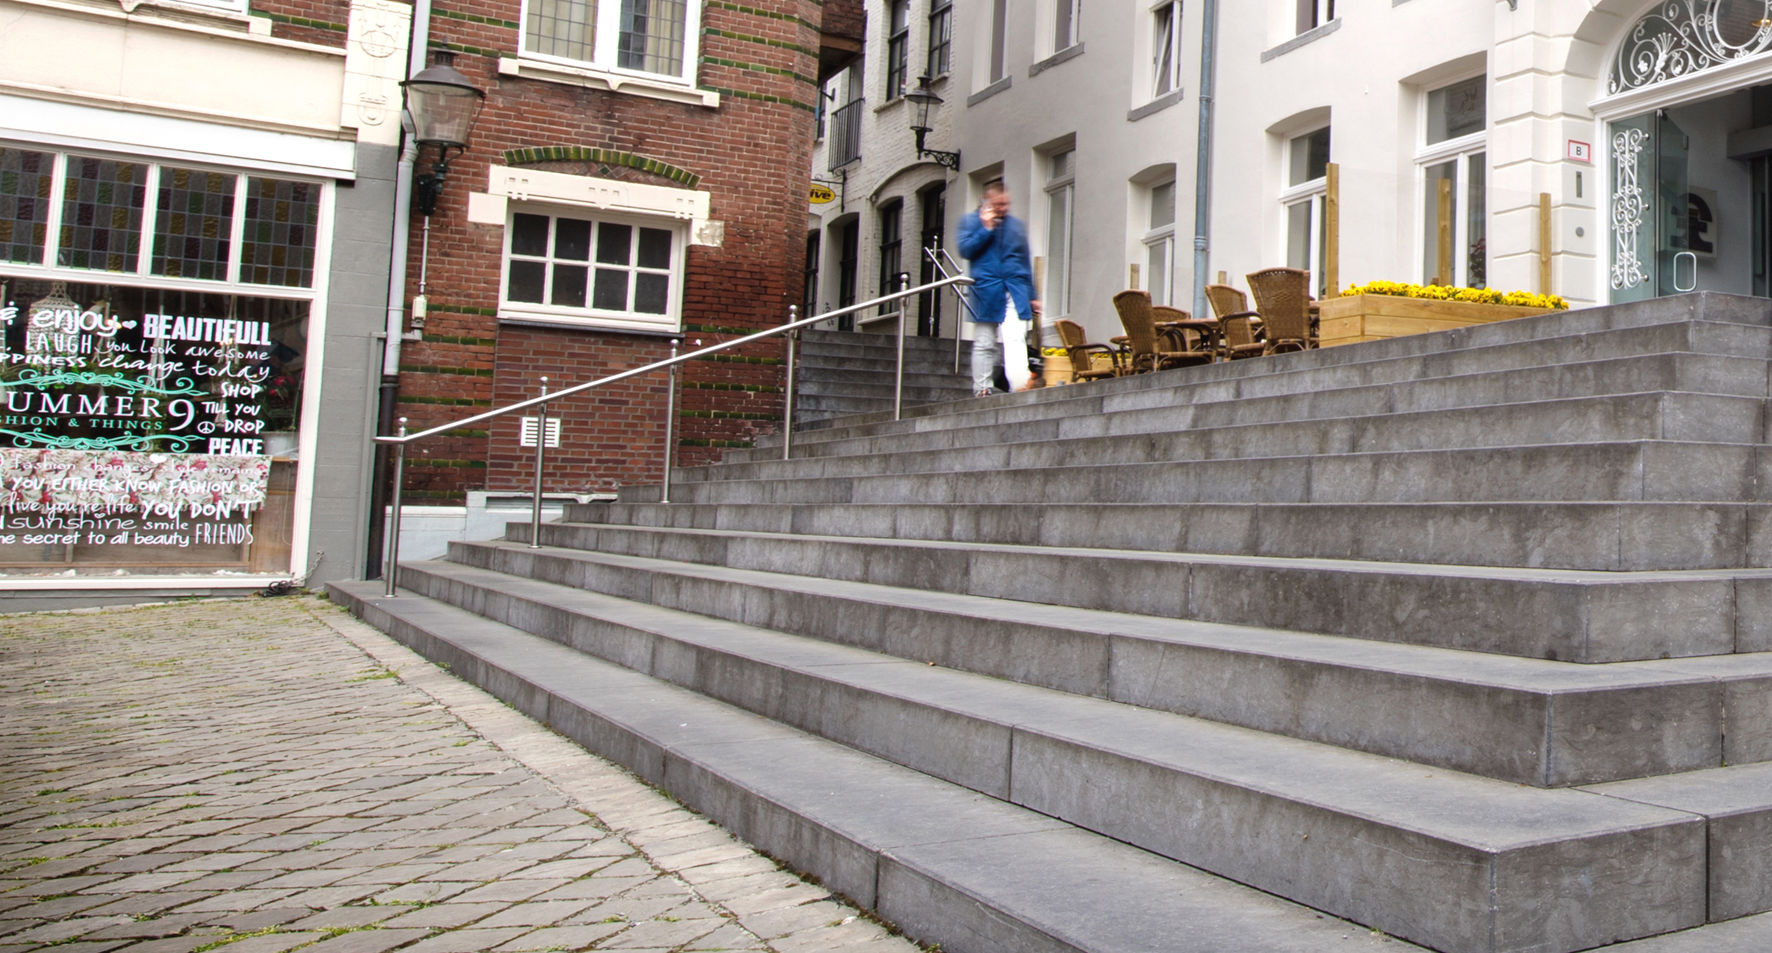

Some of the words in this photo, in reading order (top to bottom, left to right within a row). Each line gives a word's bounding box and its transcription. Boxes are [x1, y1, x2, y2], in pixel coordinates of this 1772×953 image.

[1576, 146, 1582, 156] B
[33, 305, 118, 337] enjoy
[143, 313, 271, 346] BEAUTIFULL
[25, 331, 92, 354] LAUGH
[94, 340, 137, 354] you
[98, 354, 185, 381] change
[192, 360, 270, 383] today
[220, 382, 261, 399] SHOP
[201, 401, 230, 414] TILL
[68, 417, 80, 427] &
[89, 418, 163, 431] THINGS
[224, 419, 265, 435] DROP
[208, 437, 263, 456] PEACE
[11, 475, 46, 492] YOU
[51, 476, 110, 492] EITHER
[169, 478, 234, 495] FASHION
[105, 492, 136, 516] life
[141, 499, 182, 520] YOU
[7, 510, 137, 529] sunshine
[143, 518, 189, 531] smile
[22, 531, 81, 545] secret
[88, 531, 106, 545] to
[110, 531, 129, 545] all
[134, 532, 190, 547] beauty
[194, 522, 254, 545] FRIENDS
